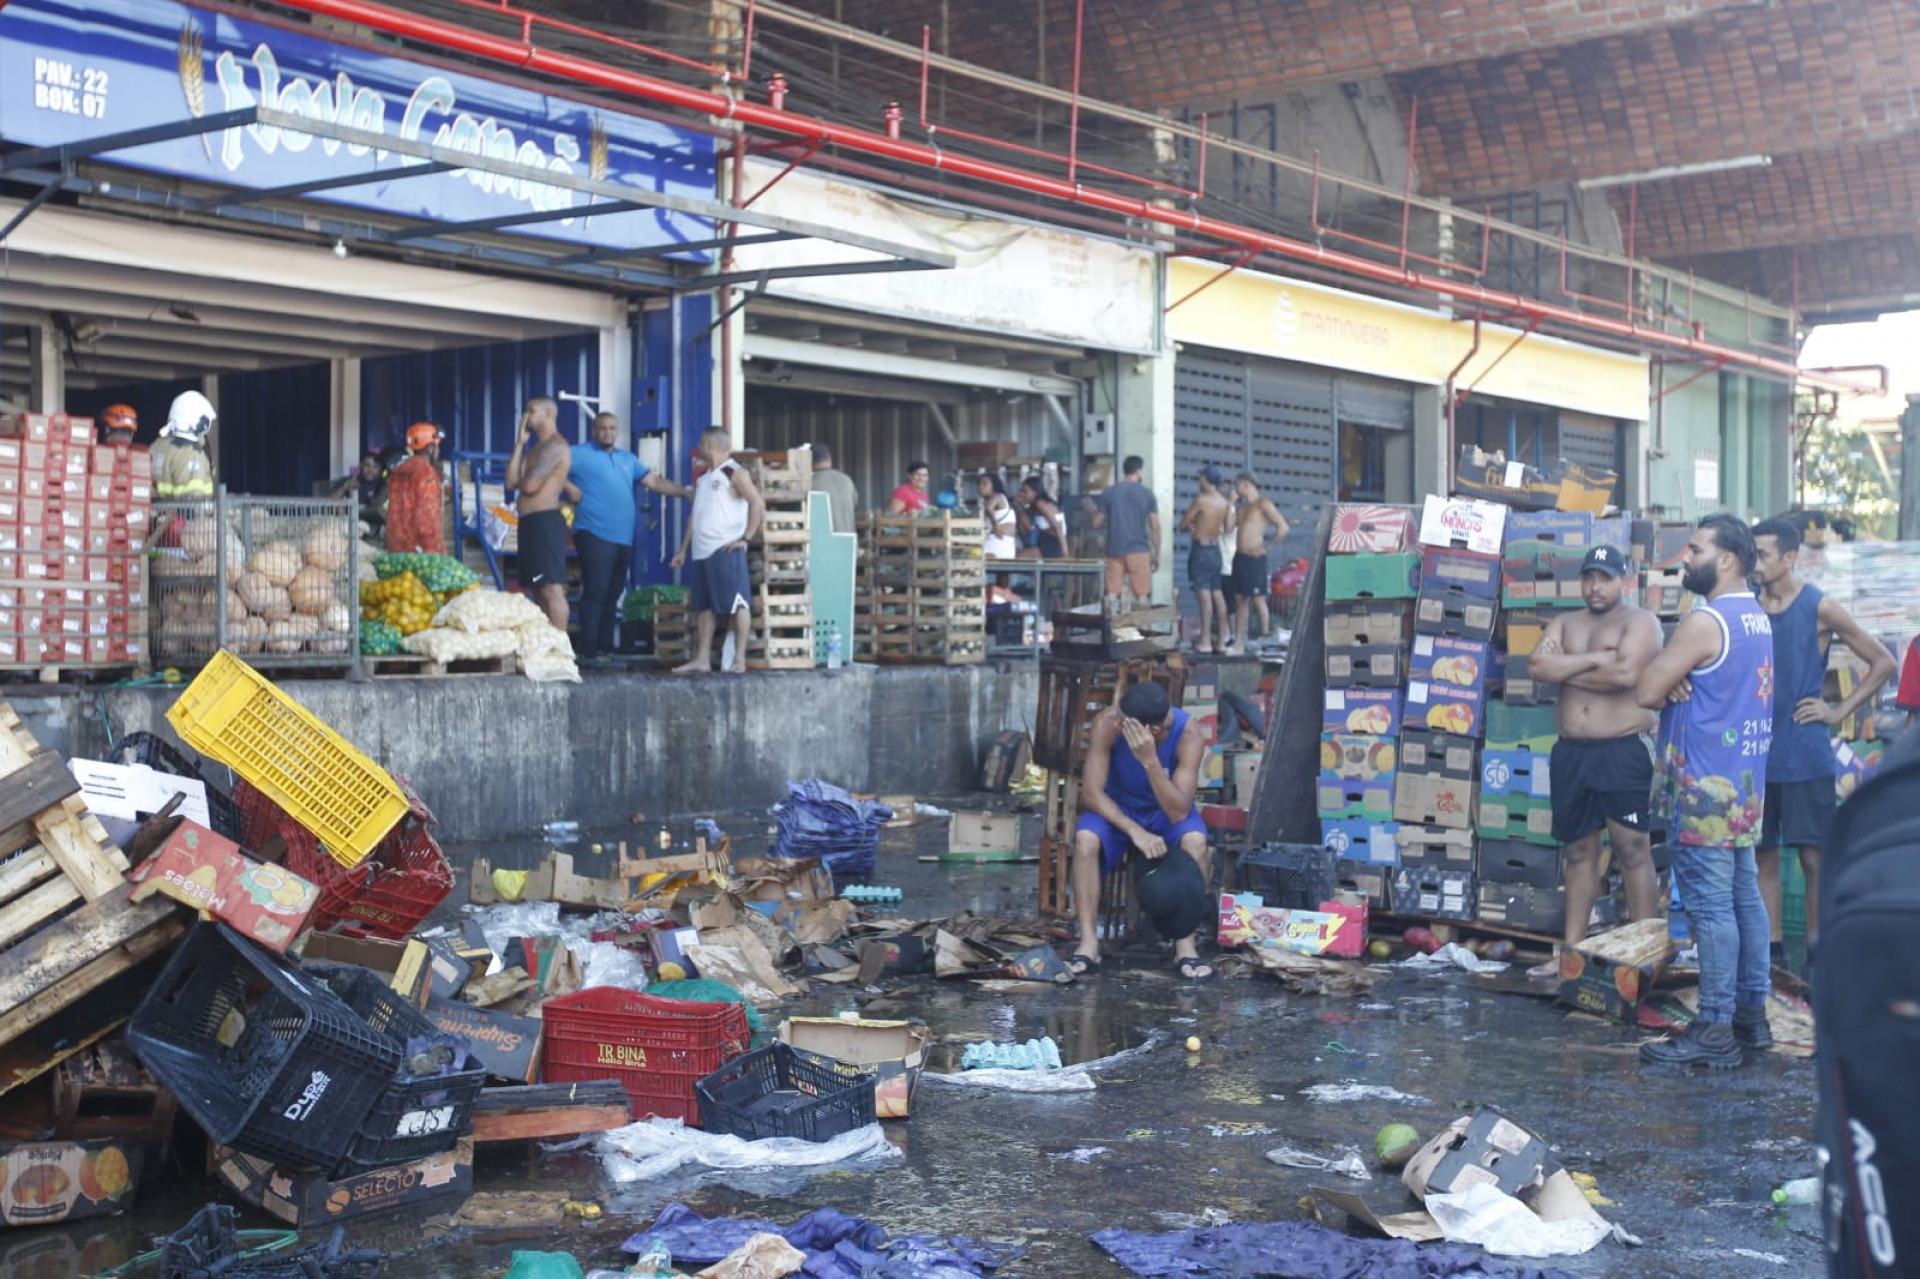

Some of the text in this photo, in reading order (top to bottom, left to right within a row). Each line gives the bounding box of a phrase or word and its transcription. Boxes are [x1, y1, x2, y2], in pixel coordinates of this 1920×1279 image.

[83, 67, 108, 95] 22
[35, 83, 107, 119] BOX: 07
[216, 43, 388, 171] Nova
[1743, 720, 1758, 735] 21
[1741, 740, 1758, 756] 21
[163, 868, 227, 912] Melões
[597, 1043, 647, 1062] TR BINA
[353, 1170, 416, 1201] SELECTO
